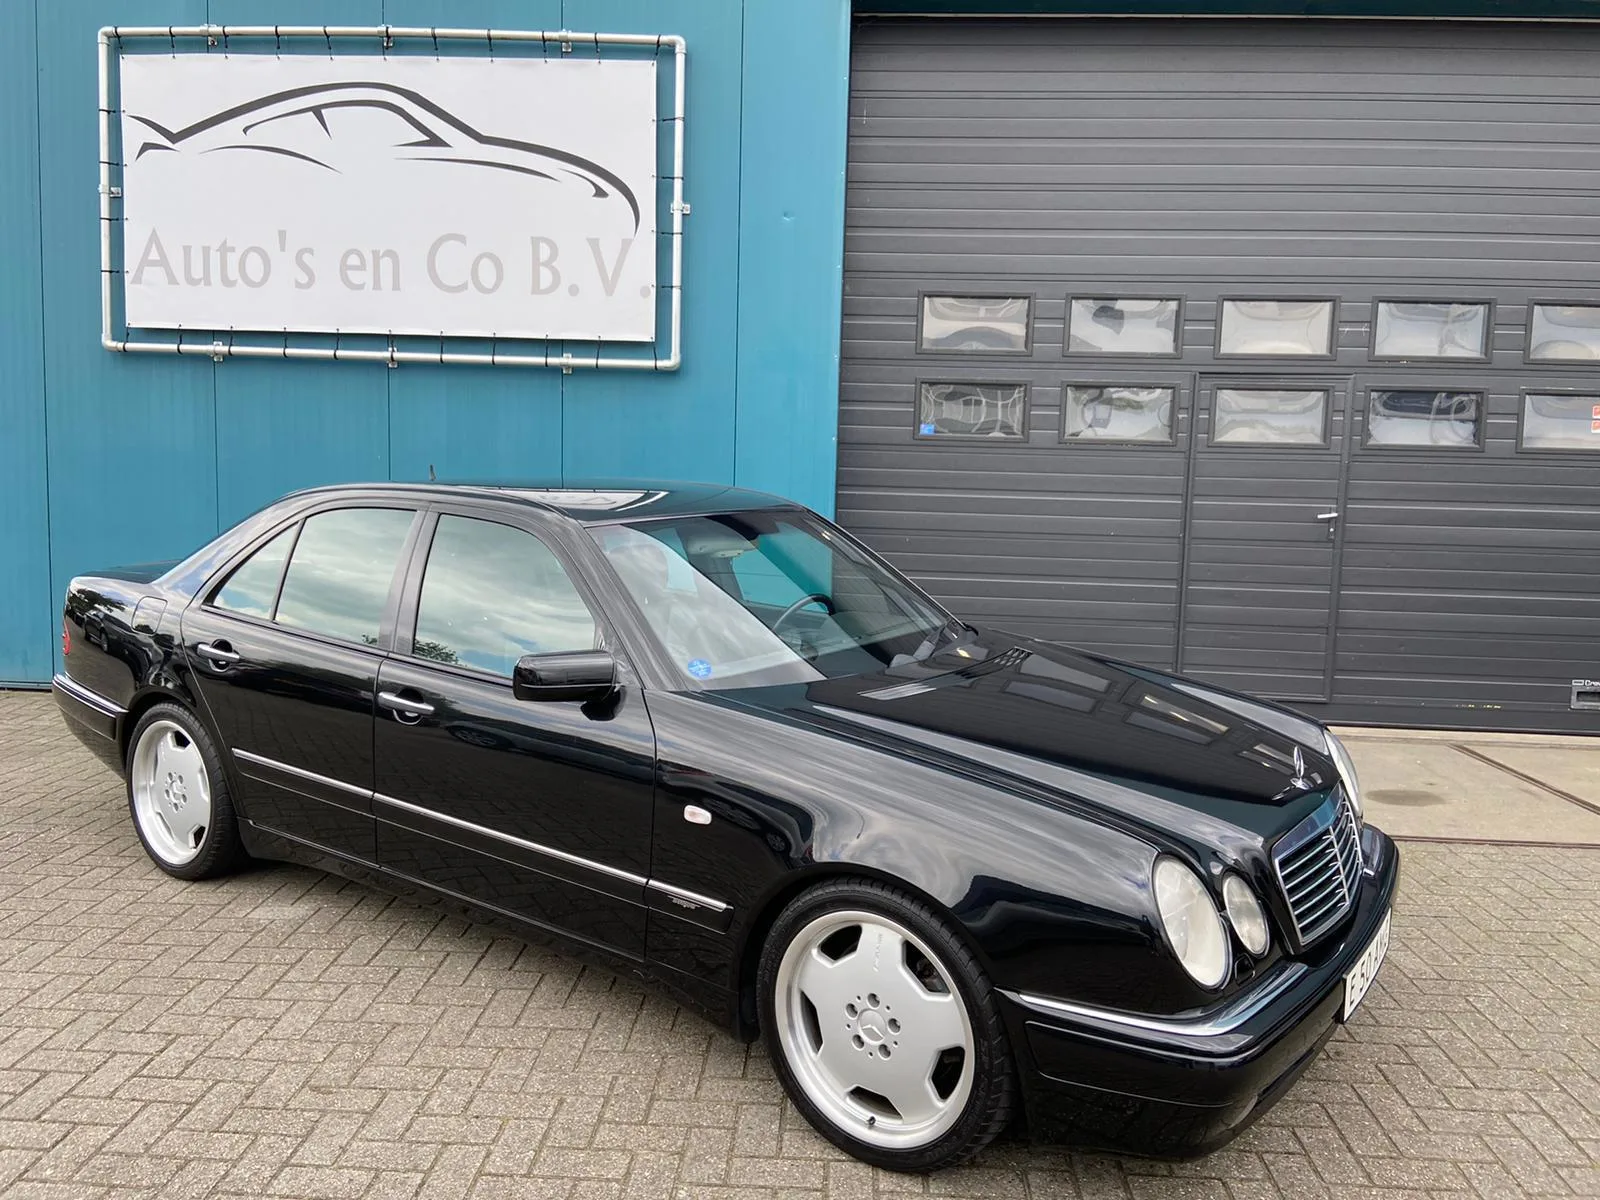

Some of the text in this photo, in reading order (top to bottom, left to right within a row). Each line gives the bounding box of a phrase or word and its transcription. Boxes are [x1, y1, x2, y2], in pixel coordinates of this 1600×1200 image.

[130, 227, 651, 298] Auto's en Co B.V.
